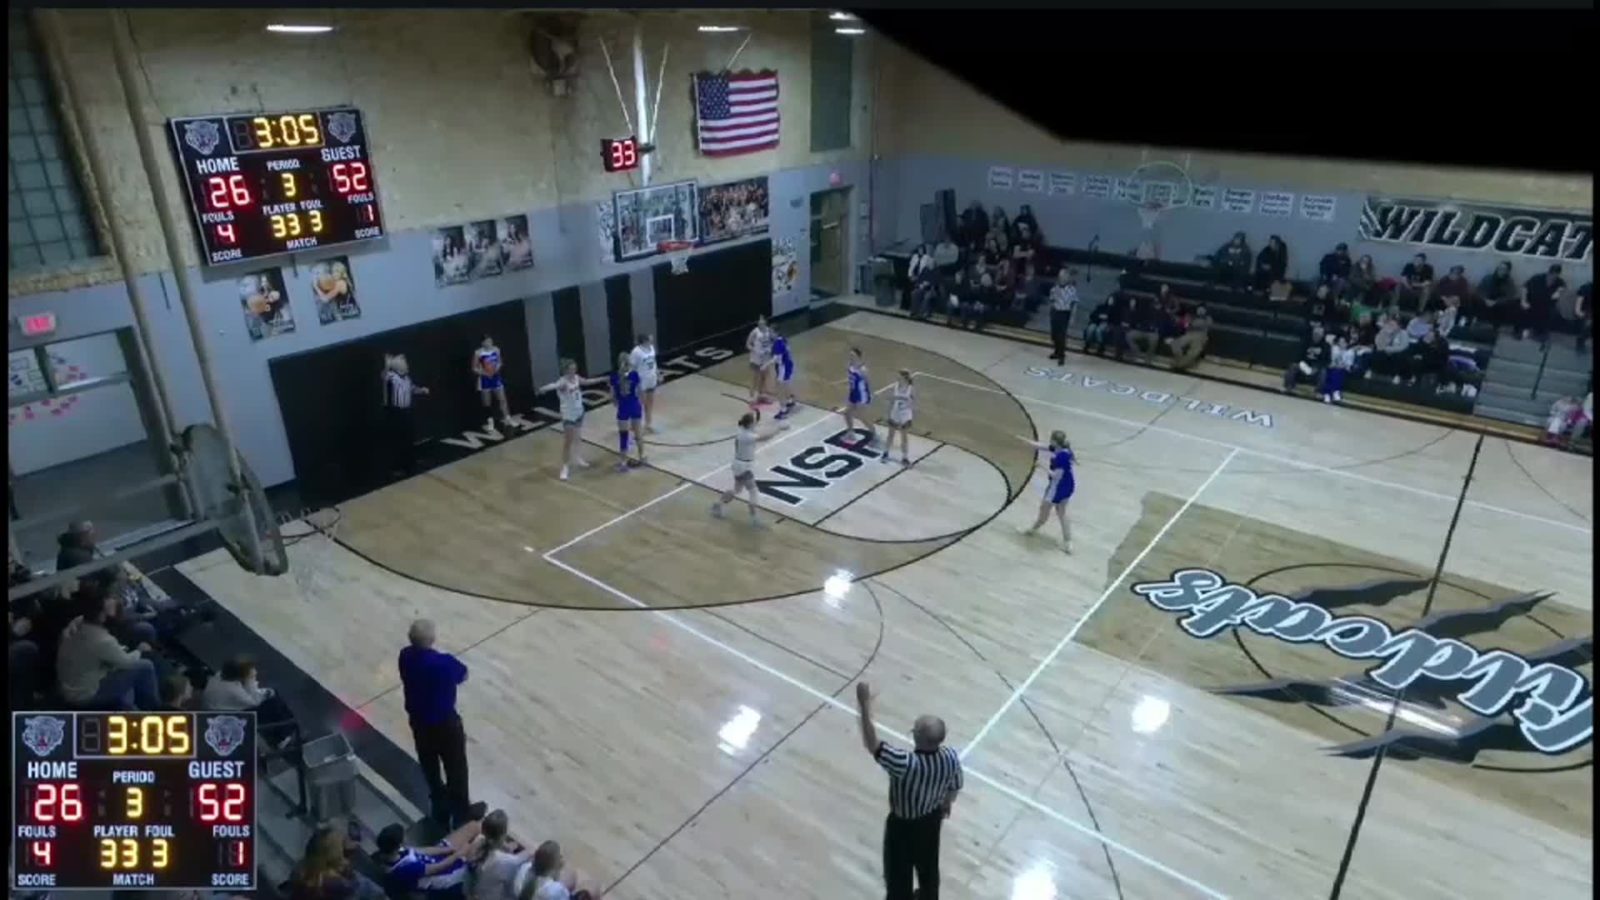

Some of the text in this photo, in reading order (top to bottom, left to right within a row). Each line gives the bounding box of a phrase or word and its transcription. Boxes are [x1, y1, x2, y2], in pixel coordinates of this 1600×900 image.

[253, 114, 319, 149] 3:05
[320, 144, 362, 162] GUEST
[610, 140, 636, 168] 33
[195, 156, 240, 175] HOME
[265, 158, 301, 171] PERIOD
[281, 172, 297, 198] 3
[332, 161, 368, 194] 52
[208, 174, 251, 208] 26
[347, 192, 375, 205] FOULS
[262, 199, 324, 216] PLAYER FOUL
[366, 204, 375, 222] 1
[201, 210, 235, 225] FOULS
[270, 213, 302, 239] 33
[309, 209, 324, 233] 3
[215, 223, 236, 243] 4
[354, 226, 381, 239] SCORE
[285, 236, 318, 250] MATCH
[211, 247, 243, 263] SCORE
[1022, 365, 1275, 429] WILDCATS
[754, 427, 882, 506] NSP
